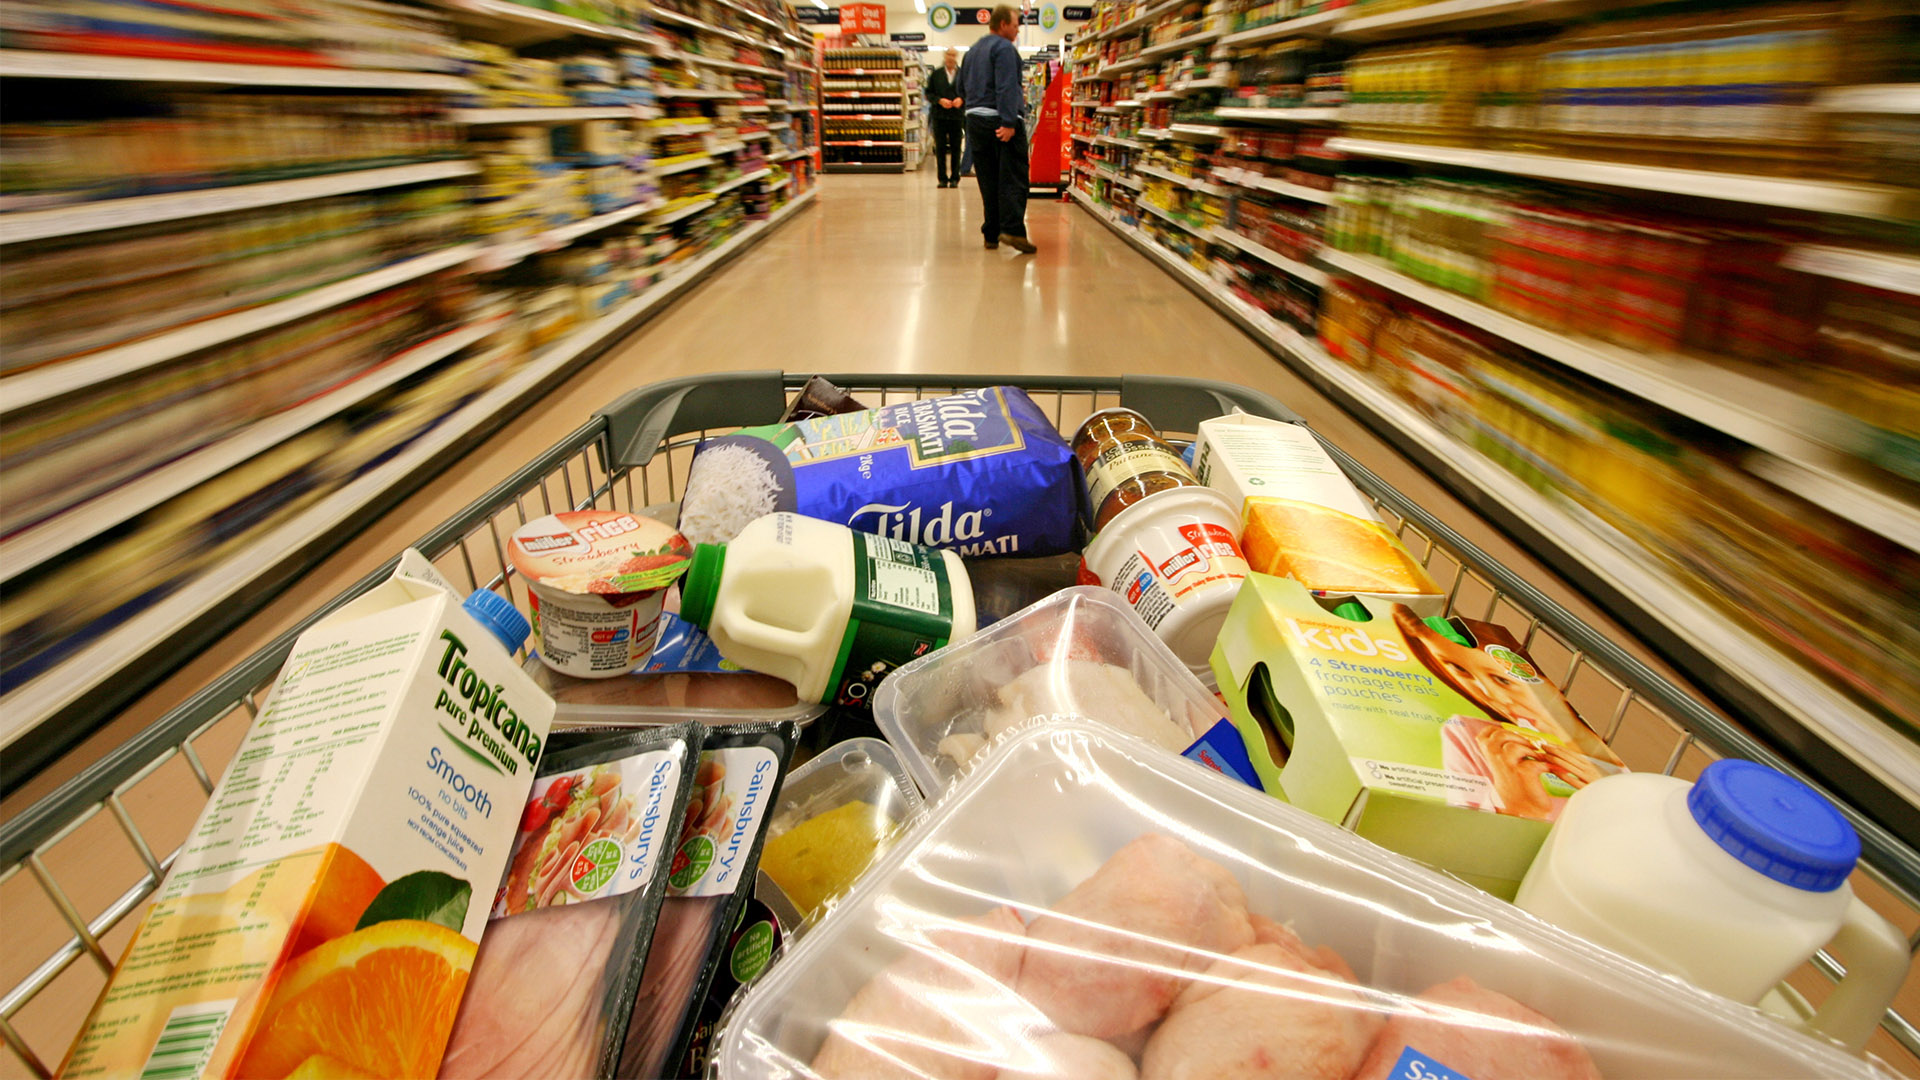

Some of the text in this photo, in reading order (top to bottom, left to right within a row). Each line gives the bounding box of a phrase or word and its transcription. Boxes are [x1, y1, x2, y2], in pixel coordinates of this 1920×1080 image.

[862, 6, 880, 19] Great
[863, 18, 880, 29] offers
[1066, 9, 1084, 17] Gravy
[578, 516, 640, 542] rice
[848, 501, 985, 547] Tilda
[552, 542, 640, 566] Strawberry
[1162, 551, 1196, 577] müller
[1285, 617, 1408, 662] kids
[1309, 657, 1433, 686] 4 Strawberry
[1314, 669, 1440, 697] fromage frais
[437, 628, 543, 768] Tropicana
[1323, 684, 1403, 704] pouches
[1332, 701, 1362, 712] made
[1365, 704, 1387, 714] with
[1388, 708, 1409, 718] real
[1410, 710, 1434, 722] fruit
[433, 688, 468, 726] pure
[466, 716, 518, 777] premium
[426, 746, 493, 819] Smooth
[438, 788, 468, 820] no bits
[408, 785, 484, 856] 100% pure squeezed
[421, 814, 465, 854] orange juice
[629, 759, 673, 881] Sainsbury's
[716, 759, 772, 883] Sainsbury's
[737, 934, 770, 961] artificial
[750, 931, 761, 943] No
